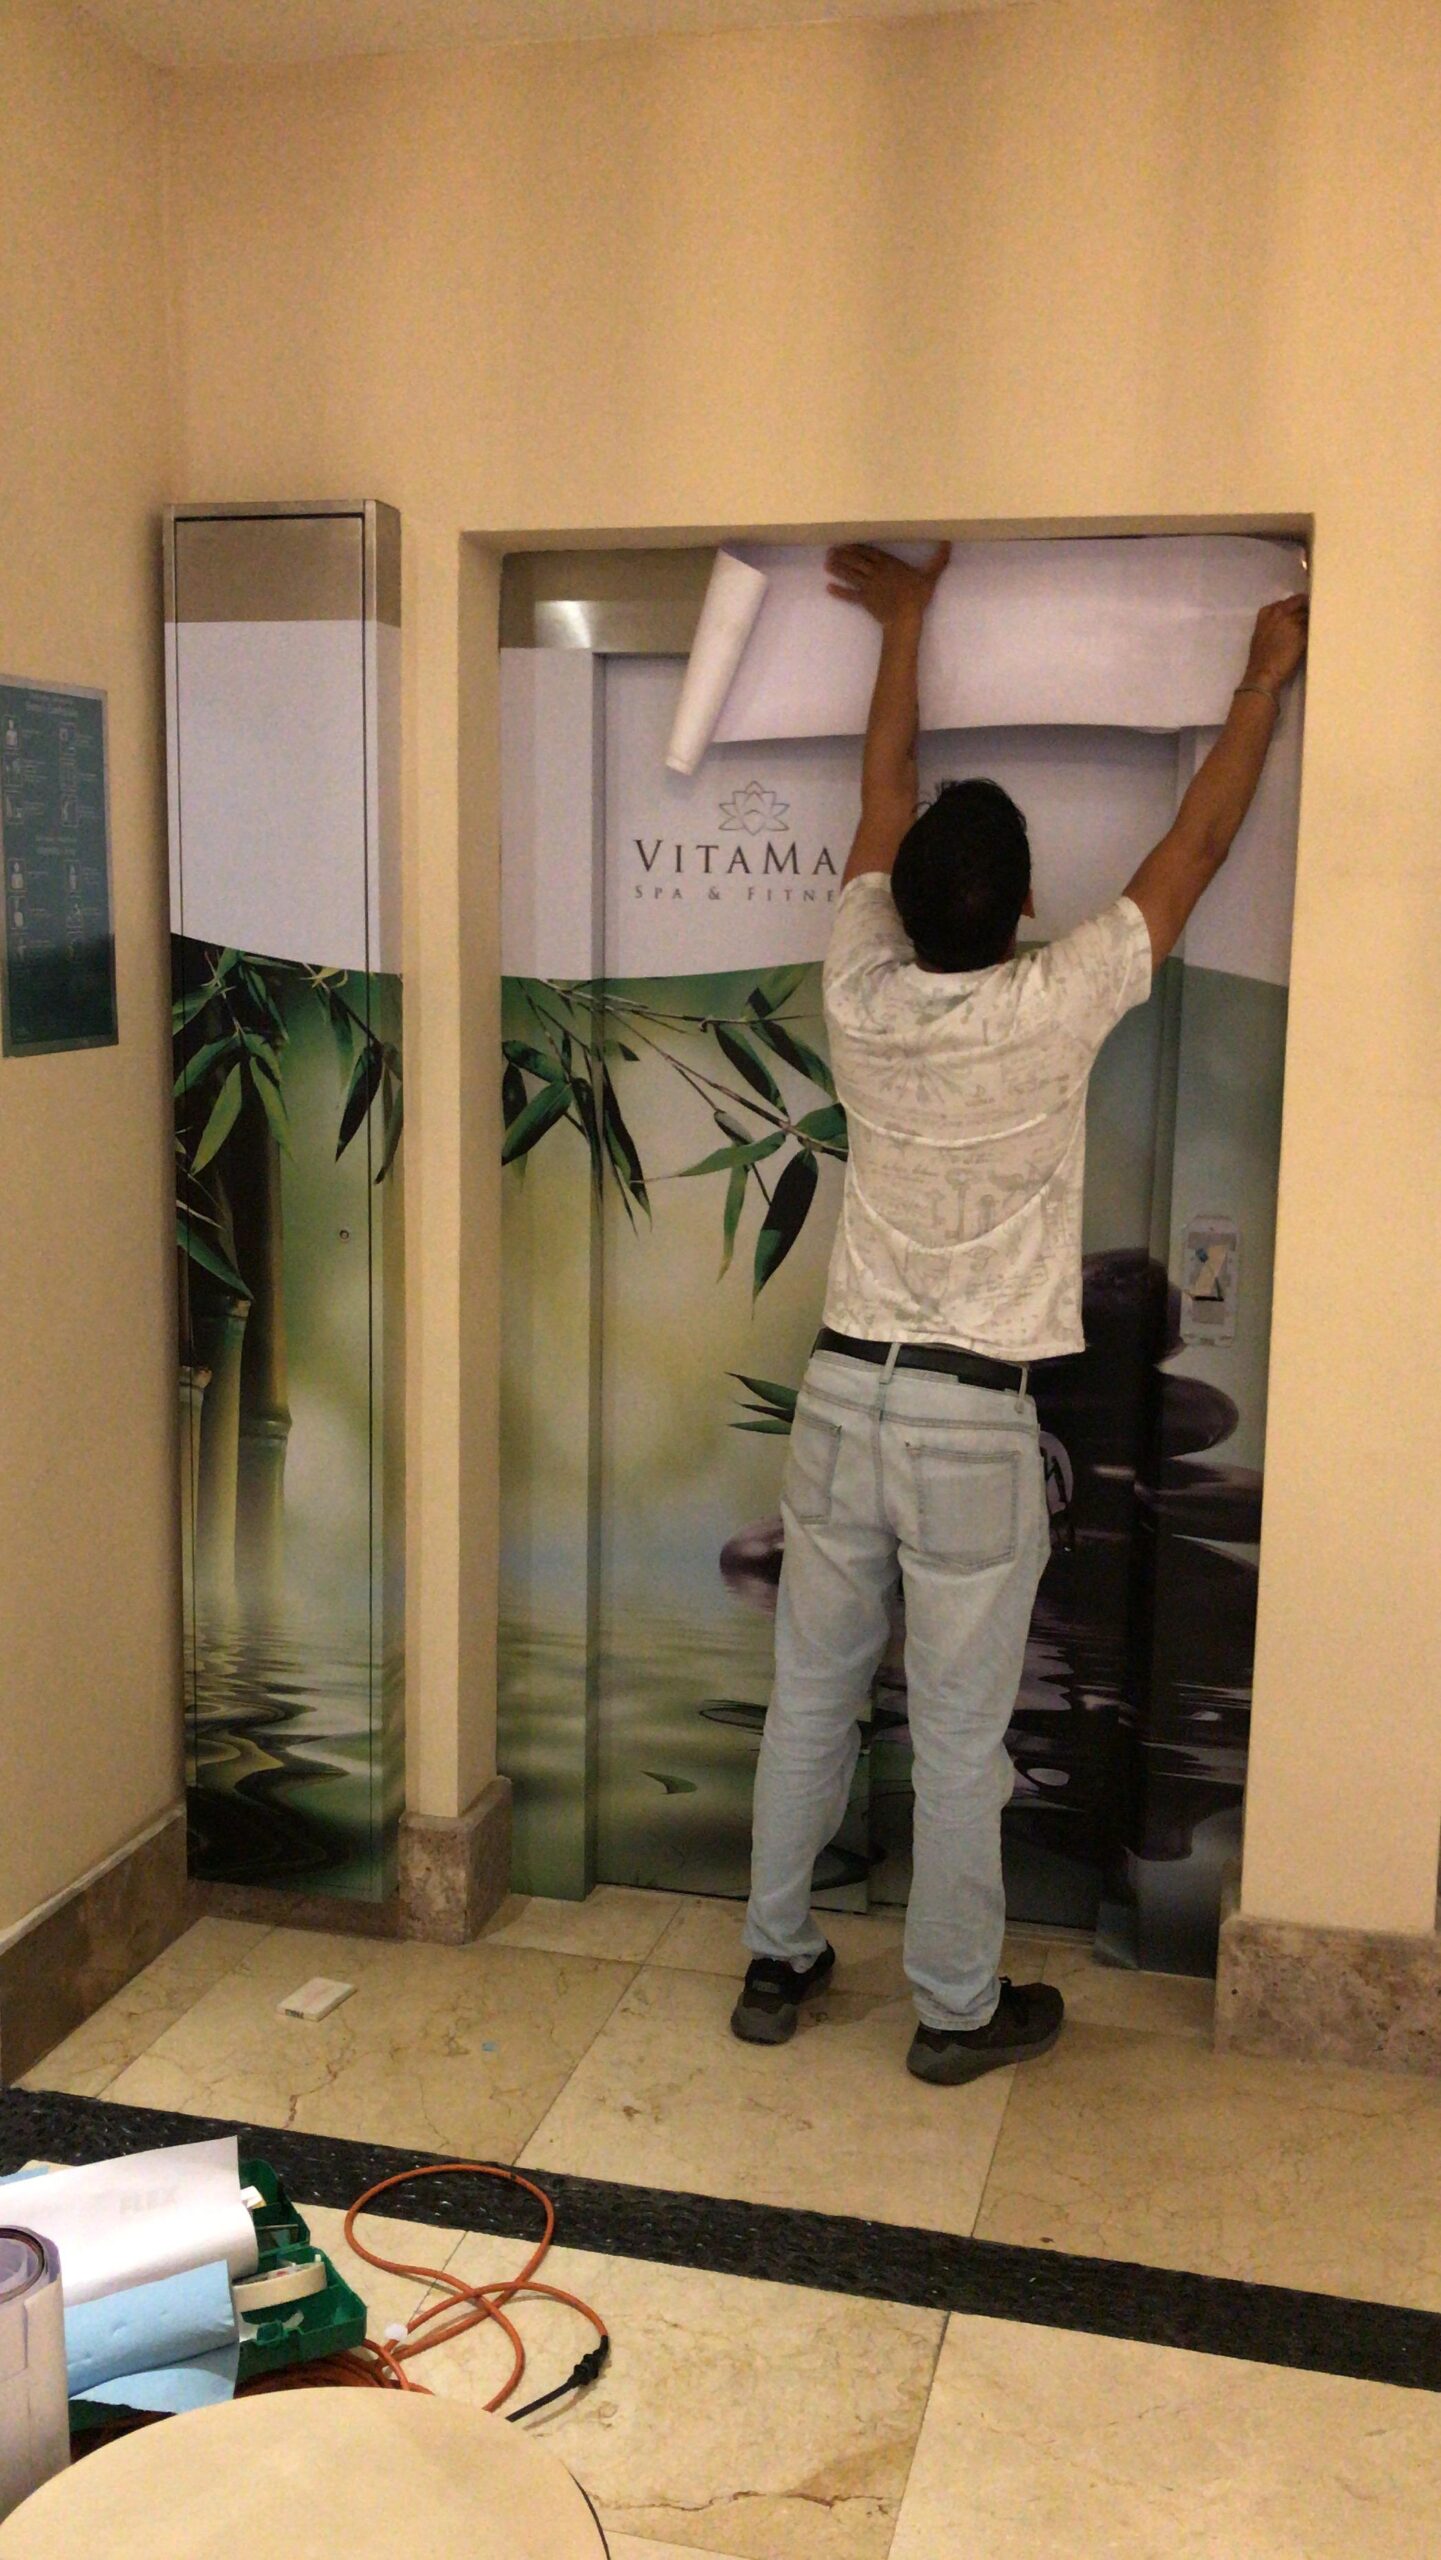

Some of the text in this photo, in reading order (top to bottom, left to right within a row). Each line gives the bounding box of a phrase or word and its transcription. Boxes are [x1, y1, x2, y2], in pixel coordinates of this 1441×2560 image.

[634, 839, 838, 875] VITAMA
[635, 884, 835, 903] SPA & FITNE
